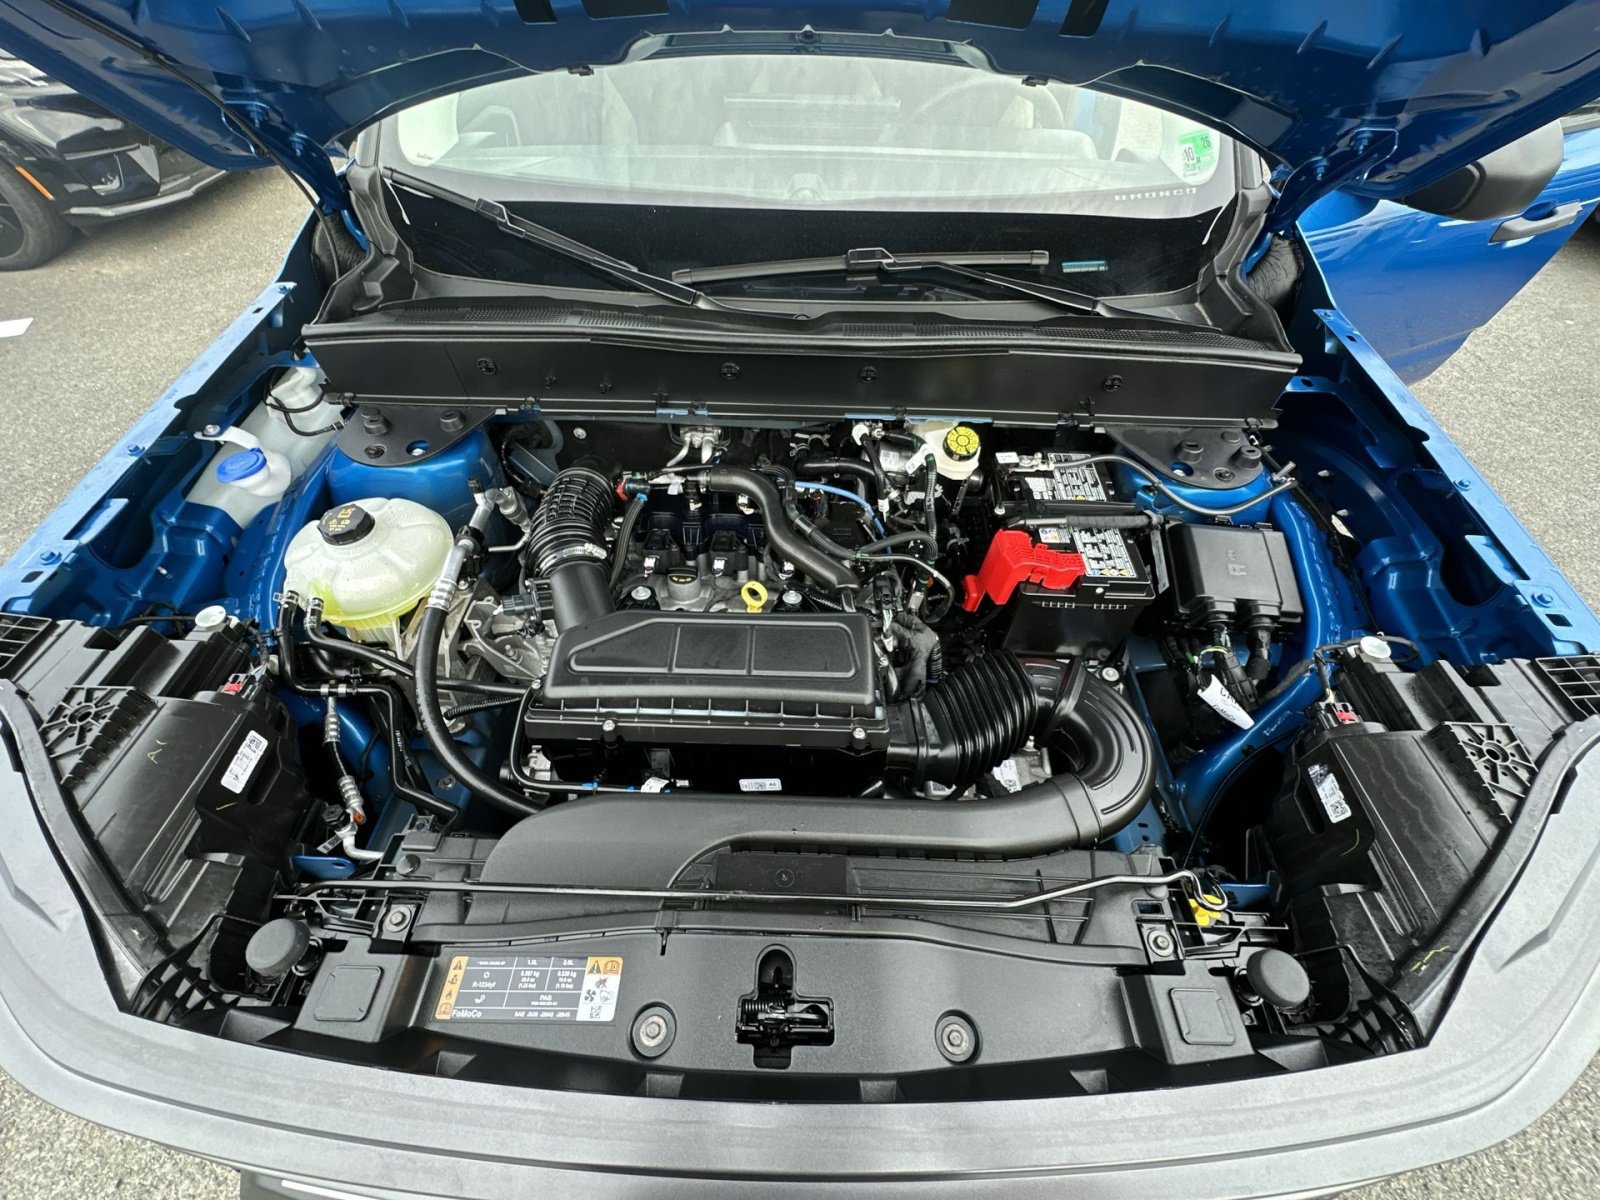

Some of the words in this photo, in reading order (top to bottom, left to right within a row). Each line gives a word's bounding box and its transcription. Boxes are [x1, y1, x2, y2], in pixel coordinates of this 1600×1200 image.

[1183, 146, 1195, 163] 10
[1114, 187, 1197, 201] BRONCO
[472, 981, 496, 989] R-1234yf
[451, 1009, 482, 1018] FoMoCo
